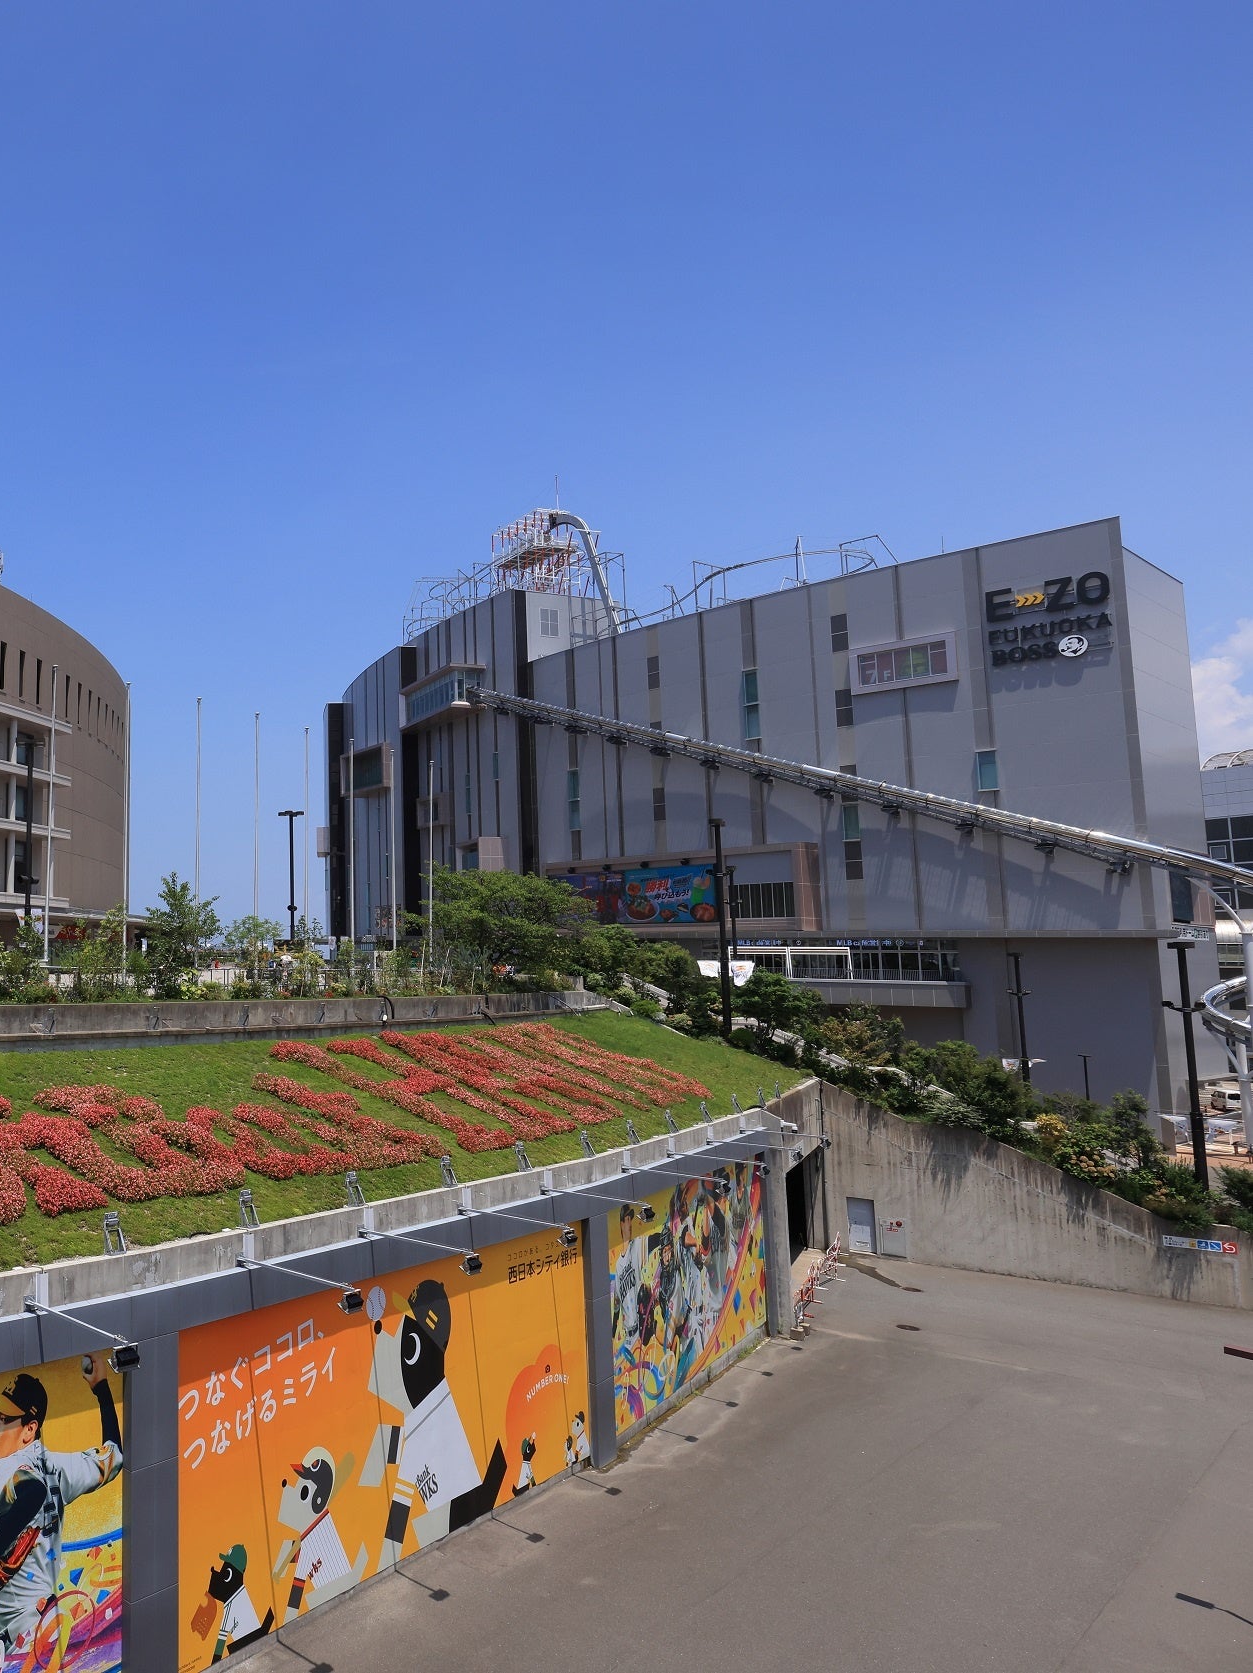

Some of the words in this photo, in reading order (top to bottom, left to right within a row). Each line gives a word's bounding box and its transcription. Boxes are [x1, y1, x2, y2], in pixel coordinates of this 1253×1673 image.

[988, 612, 1113, 645] FUKUOKA
[991, 641, 1057, 666] BOSS
[508, 1248, 578, 1284] 西日本シティ銀行
[178, 1318, 325, 1421] つなぐココロ、
[526, 1374, 554, 1403] NUMBER
[183, 1347, 336, 1470] つなげるミライ
